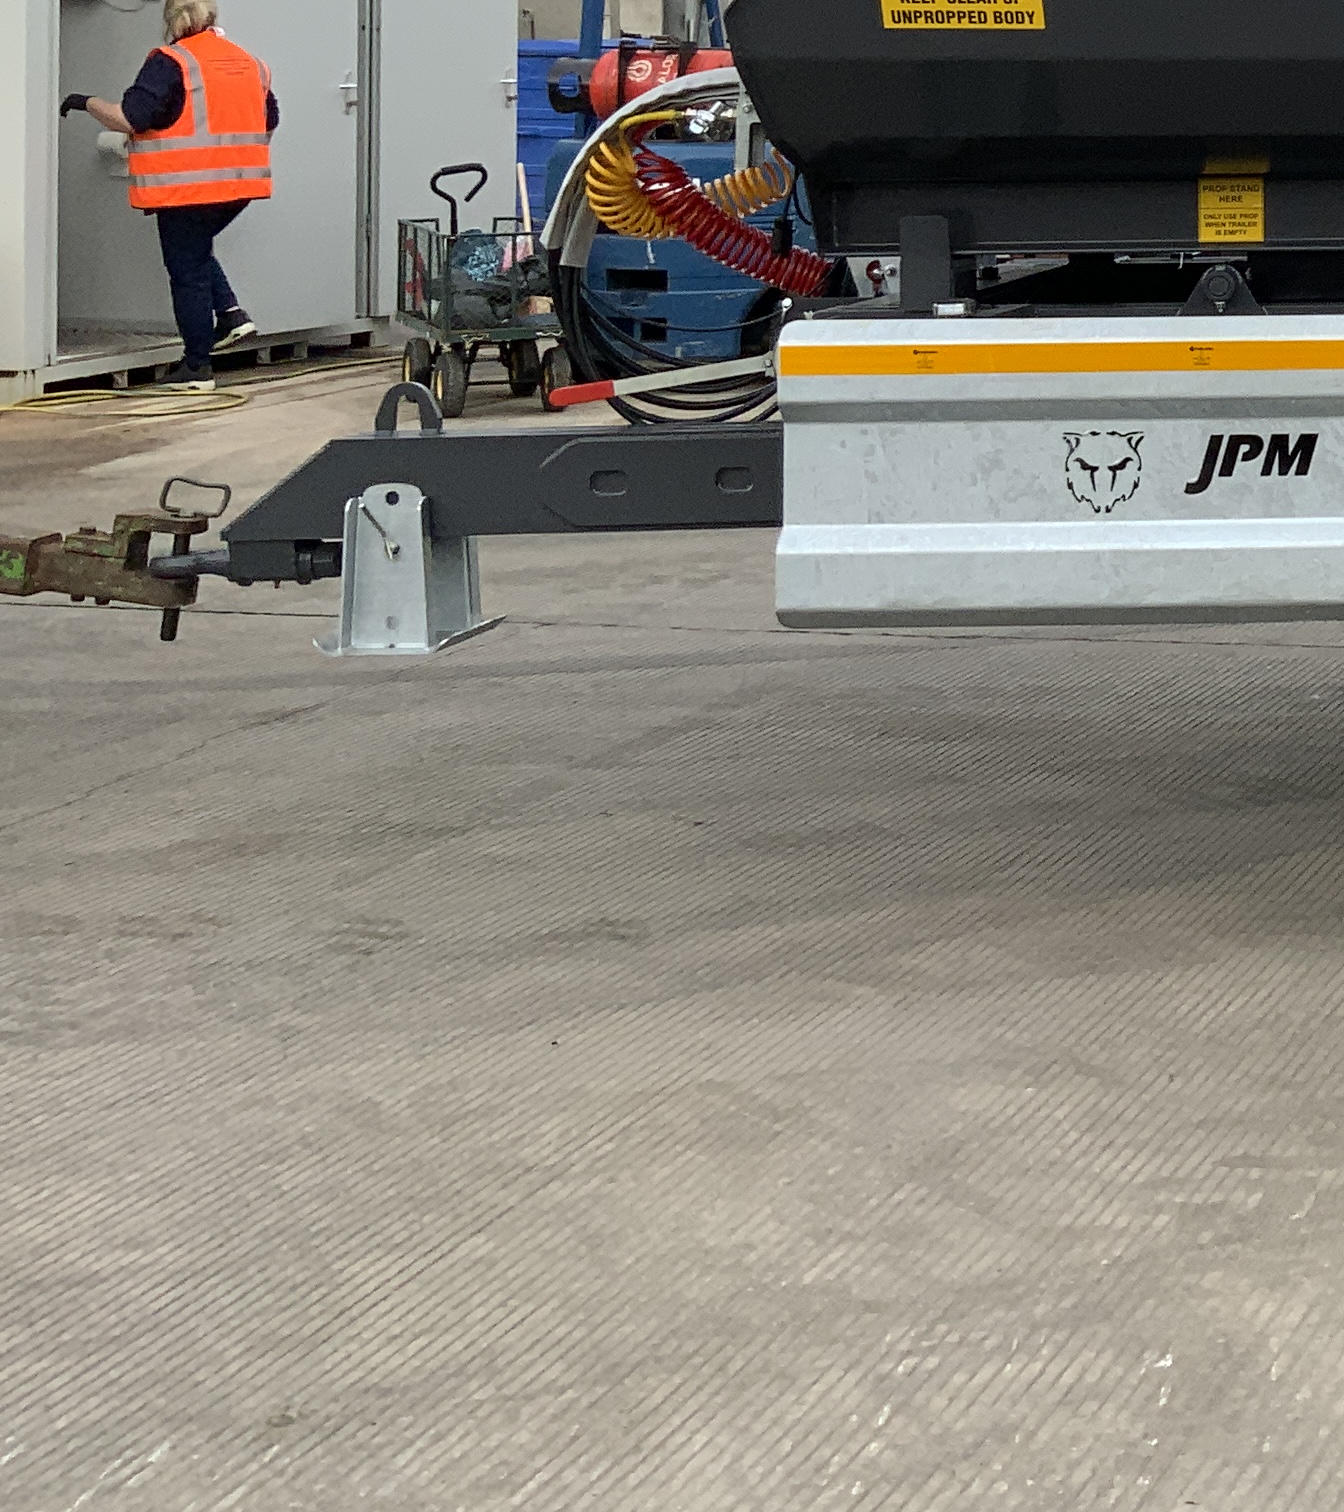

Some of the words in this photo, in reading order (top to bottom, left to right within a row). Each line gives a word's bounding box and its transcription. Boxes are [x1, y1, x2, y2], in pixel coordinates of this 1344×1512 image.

[891, 10, 987, 25] UNPROPPED
[994, 10, 1035, 25] BODY
[1202, 184, 1227, 192] PROP
[1229, 184, 1260, 192] STAND
[1219, 195, 1243, 203] HERE
[1184, 433, 1319, 495] JPM
